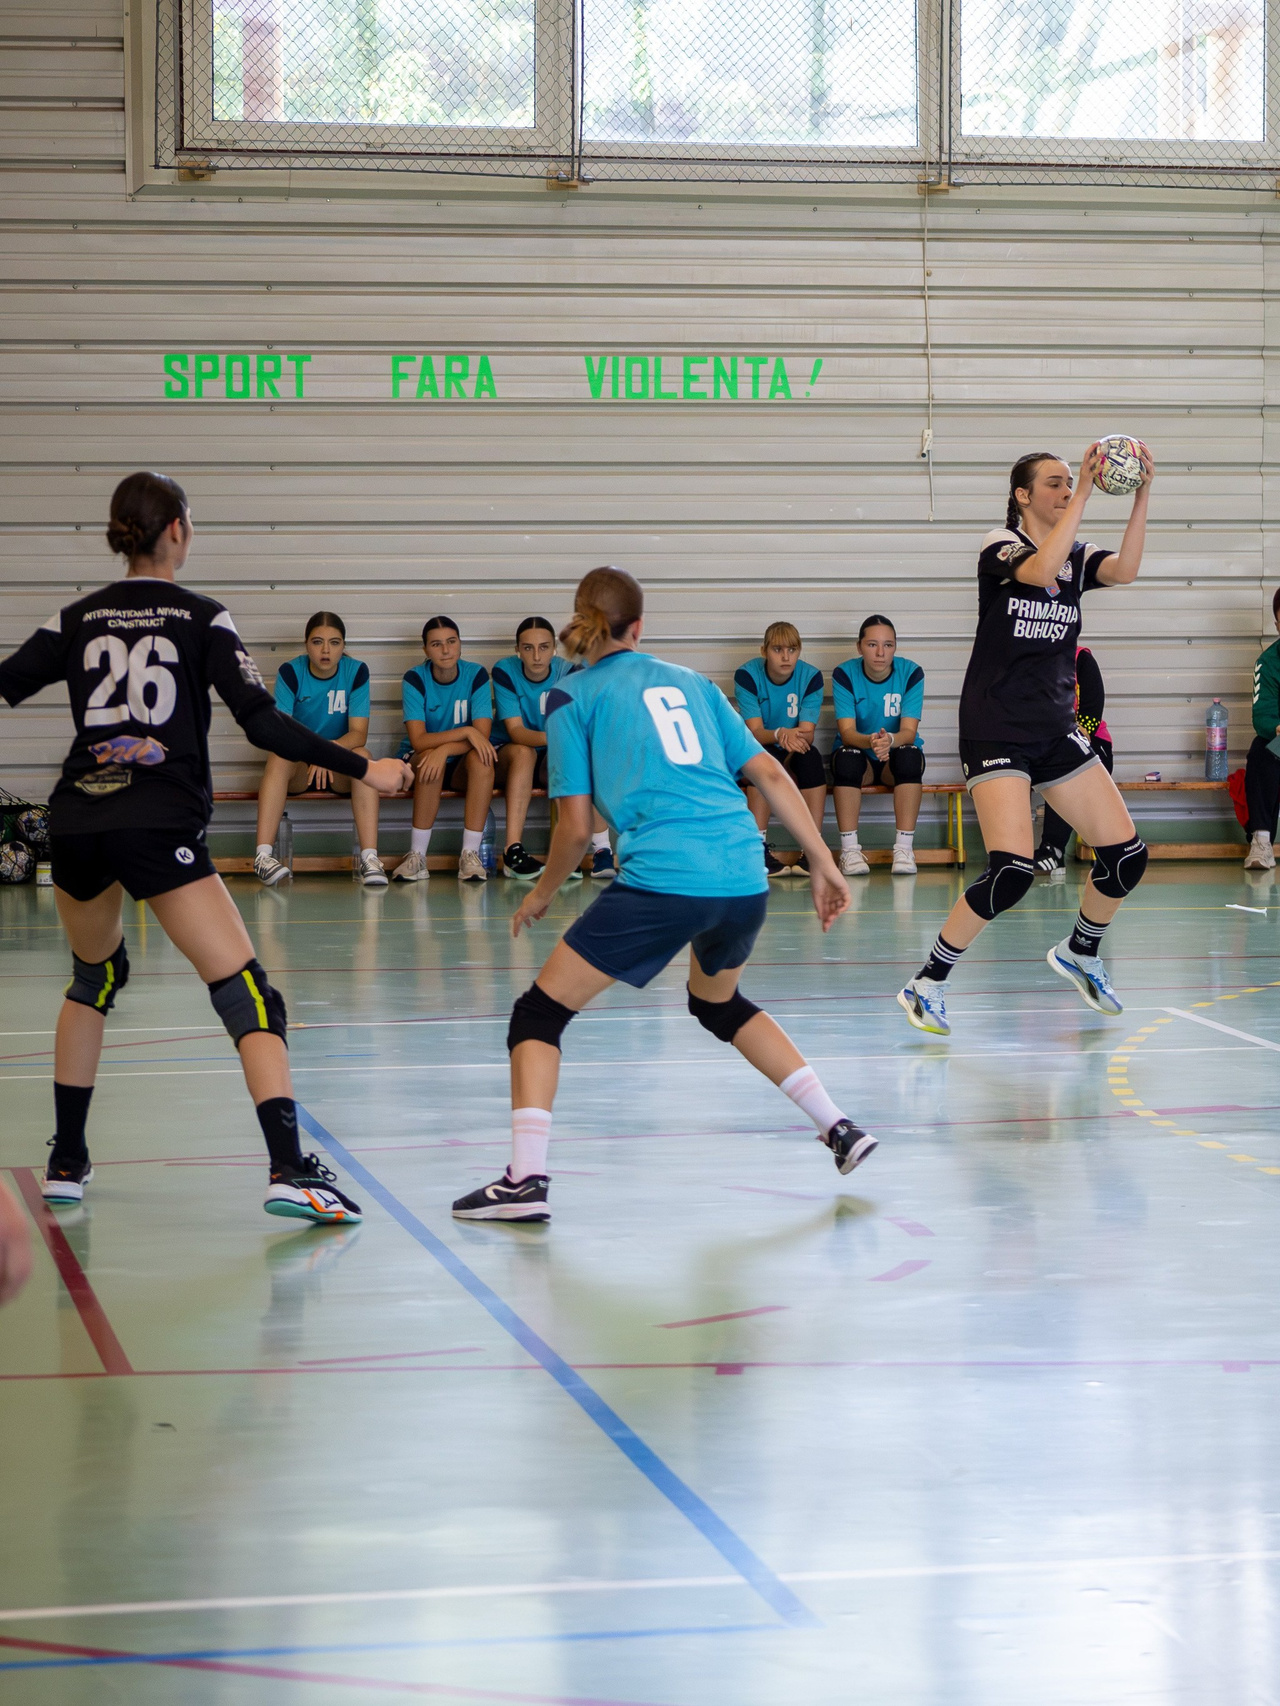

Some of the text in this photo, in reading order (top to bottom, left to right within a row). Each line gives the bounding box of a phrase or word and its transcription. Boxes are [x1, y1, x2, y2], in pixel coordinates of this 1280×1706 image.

[164, 354, 311, 398] SPORT
[392, 355, 498, 399] FARA
[1007, 597, 1079, 624] PRIMĂRIA
[1014, 619, 1068, 643] BUHUȘI
[83, 634, 180, 727] 26
[327, 690, 348, 715] 14
[454, 700, 468, 724] 11
[787, 693, 798, 718] 3
[883, 693, 902, 717] 13
[643, 686, 703, 766] 6
[982, 757, 1011, 768] Kempa
